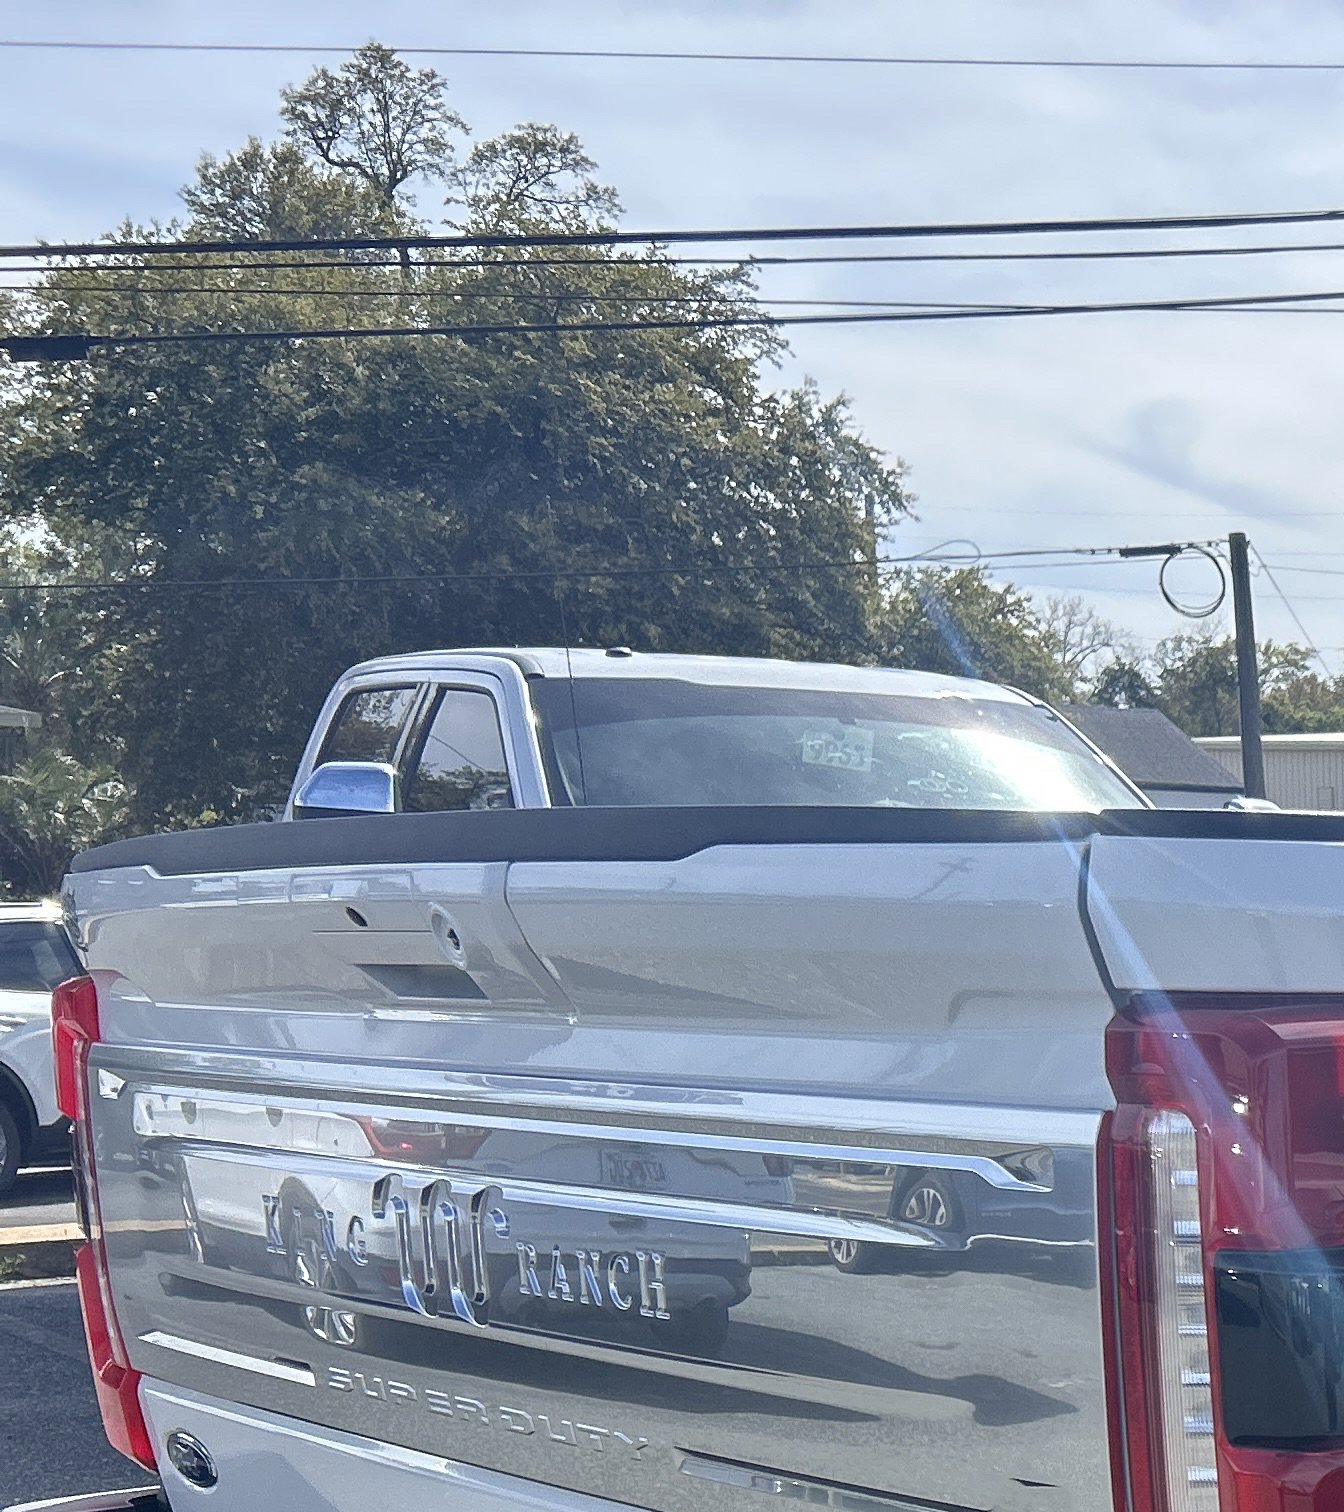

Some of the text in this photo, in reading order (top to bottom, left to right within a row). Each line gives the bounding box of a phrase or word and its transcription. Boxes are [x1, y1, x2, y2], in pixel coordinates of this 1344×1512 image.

[261, 1194, 369, 1267] KING
[515, 1241, 671, 1321] RANCH
[328, 1366, 649, 1461] SUPER DUTY
